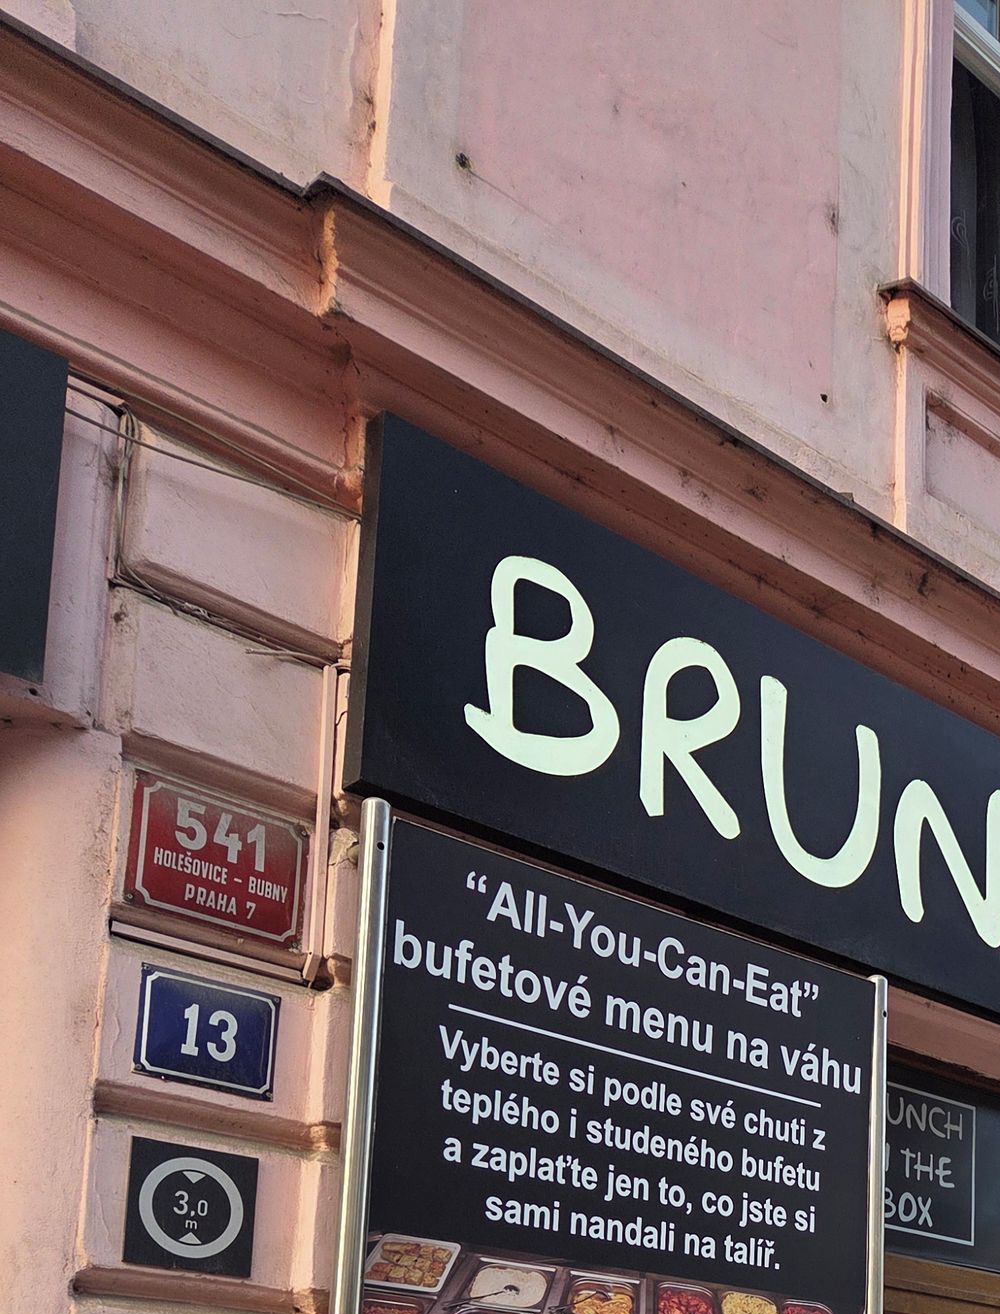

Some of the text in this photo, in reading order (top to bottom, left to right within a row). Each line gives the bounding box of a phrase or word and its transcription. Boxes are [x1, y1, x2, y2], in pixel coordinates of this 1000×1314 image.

[174, 797, 266, 873] 541
[153, 845, 228, 887] HOLEŠOVICE
[248, 875, 288, 904] BUBNY
[184, 883, 256, 921] PRAHA 7
[181, 1002, 239, 1063] 13
[393, 919, 862, 1094] bufetové menu na váhu
[439, 1025, 826, 1151] Vyberte si podle své chuti z
[441, 1079, 821, 1191] teplého i studeného bufetu
[900, 1147, 955, 1189] THE
[443, 1138, 462, 1164] a
[604, 1164, 650, 1202] jen
[658, 1177, 692, 1214] to,
[702, 1188, 734, 1217] co
[739, 1189, 787, 1228] jste
[794, 1205, 816, 1233] si
[884, 1187, 933, 1228] BOX
[185, 1218, 198, 1231] m
[485, 1195, 781, 1270] sami nandali na talíř.
